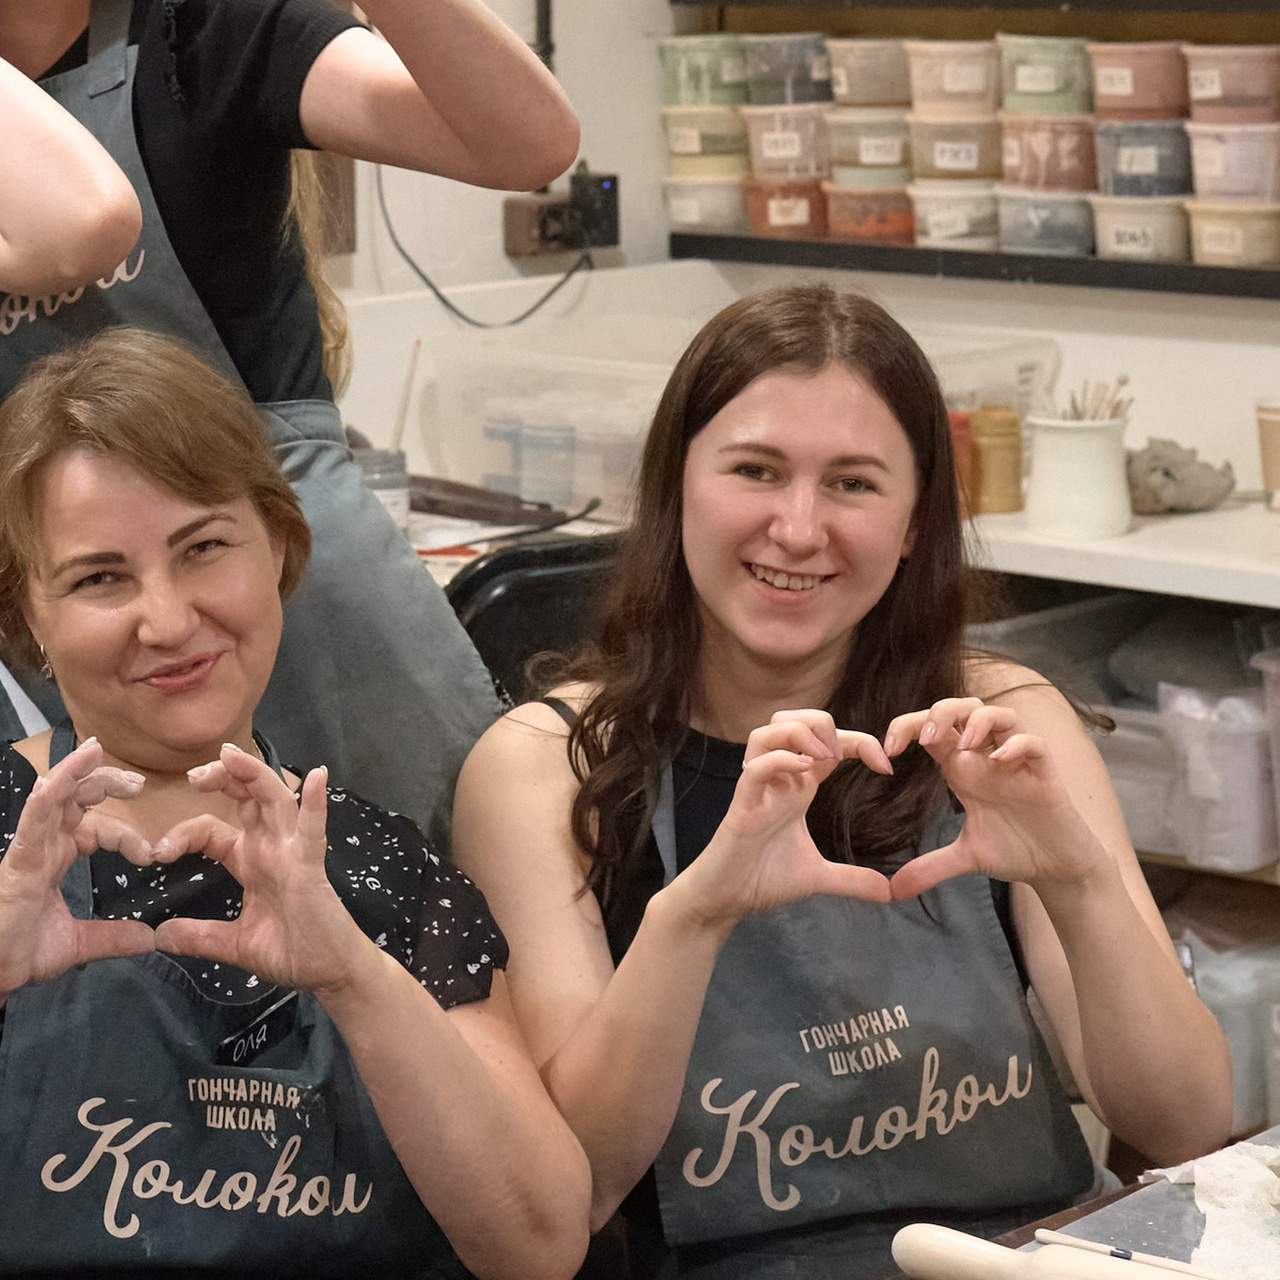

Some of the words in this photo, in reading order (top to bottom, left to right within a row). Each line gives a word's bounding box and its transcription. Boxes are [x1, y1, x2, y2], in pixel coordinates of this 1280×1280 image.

[799, 1005, 910, 1053] ГОНЧАРНАЯ
[828, 1038, 902, 1075] ШКОЛА
[188, 1078, 301, 1109] ГОНЧАРНАЯ
[206, 1104, 276, 1132] ШКОЛА
[682, 1046, 1033, 1212] Колокол
[40, 1096, 373, 1239] Колокол
